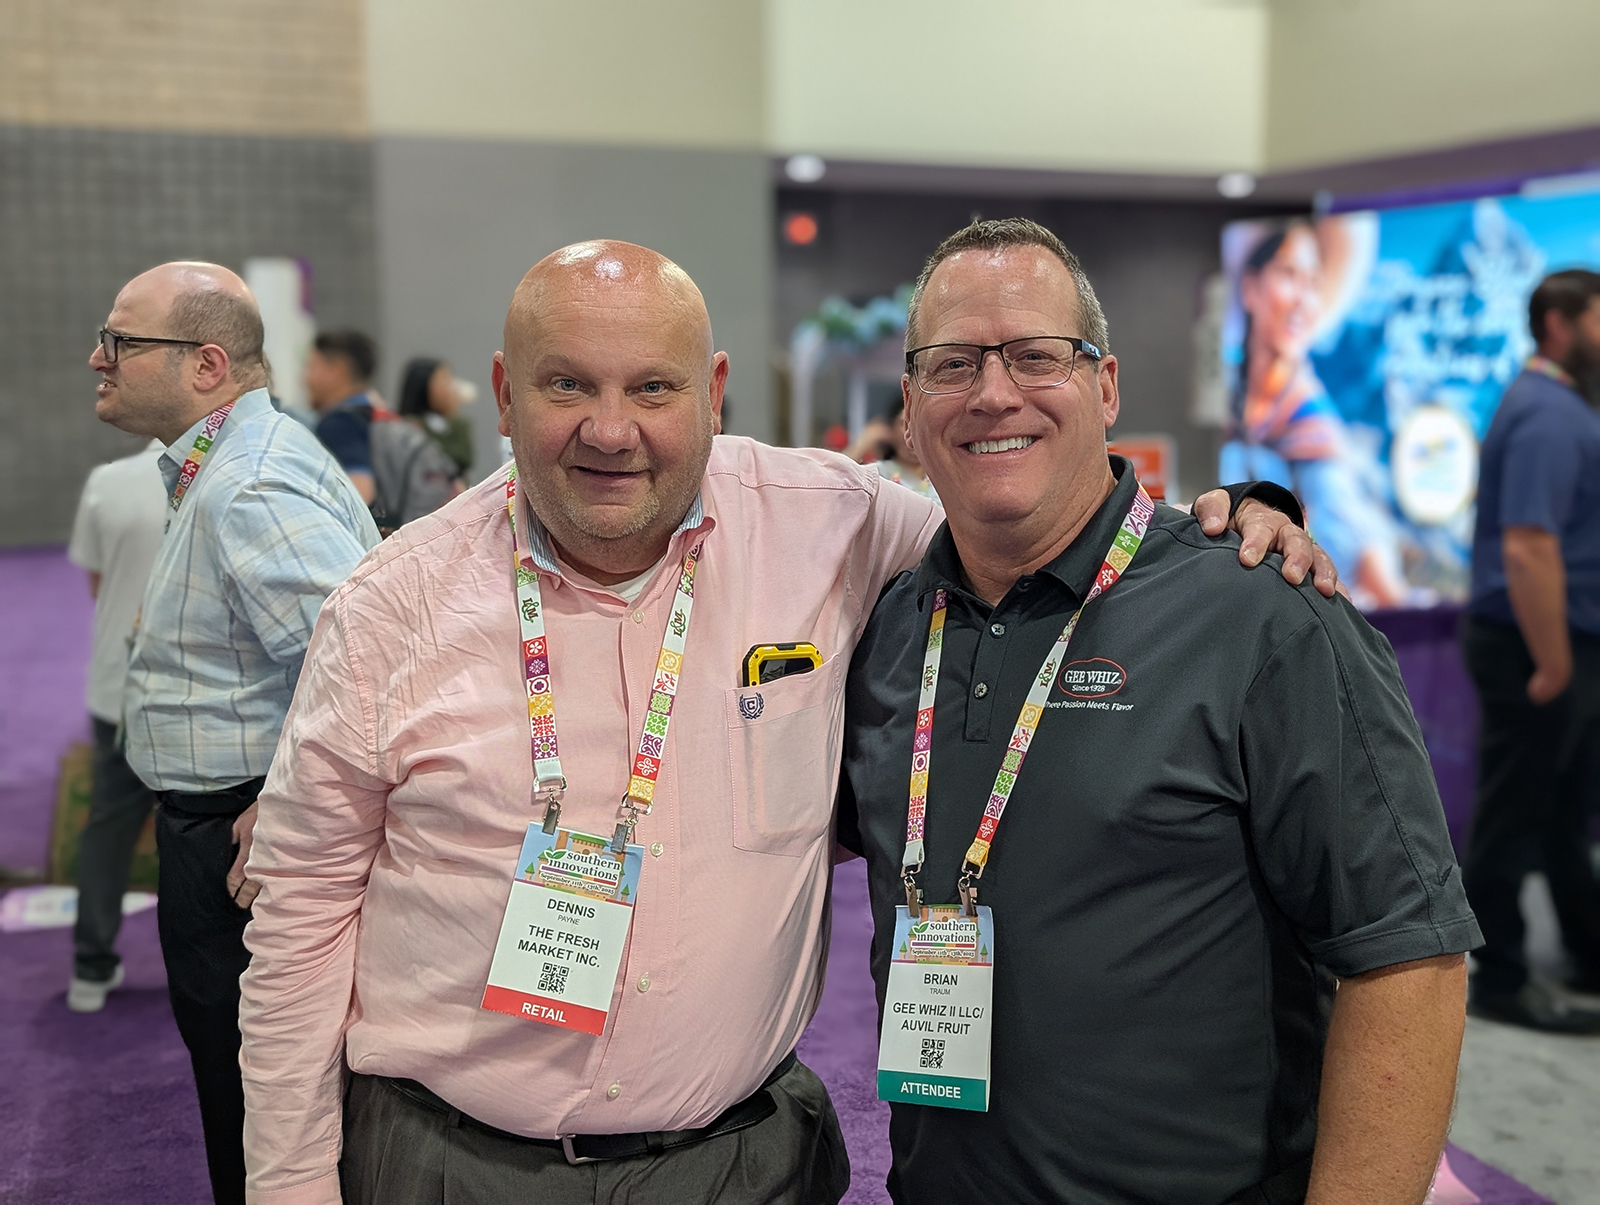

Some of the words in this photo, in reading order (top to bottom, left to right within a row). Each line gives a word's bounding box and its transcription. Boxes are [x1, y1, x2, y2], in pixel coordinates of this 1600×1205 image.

[1065, 670, 1085, 683] GEE
[1087, 701, 1109, 710] Meets
[1111, 703, 1134, 711] Flavor
[566, 852, 620, 870] southern
[541, 873, 570, 884] September
[548, 860, 618, 881] innovations
[547, 898, 596, 918] DENNIS
[558, 915, 580, 925] PAYNE
[930, 921, 976, 931] southern
[528, 925, 553, 939] THE
[556, 931, 600, 950] FRESH
[917, 932, 975, 942] innovations
[518, 939, 573, 960] MARKET
[576, 952, 600, 968] INC.
[924, 974, 958, 986] BRIAN
[521, 1002, 567, 1023] RETAIL
[893, 1002, 916, 1014] GEE
[919, 1004, 947, 1016] WHIZ
[950, 1006, 955, 1017] II
[959, 1006, 984, 1019] LLC/
[901, 1019, 934, 1032] AUVIL
[937, 1022, 970, 1035] FRUIT
[900, 1081, 961, 1099] ATTENDEE
